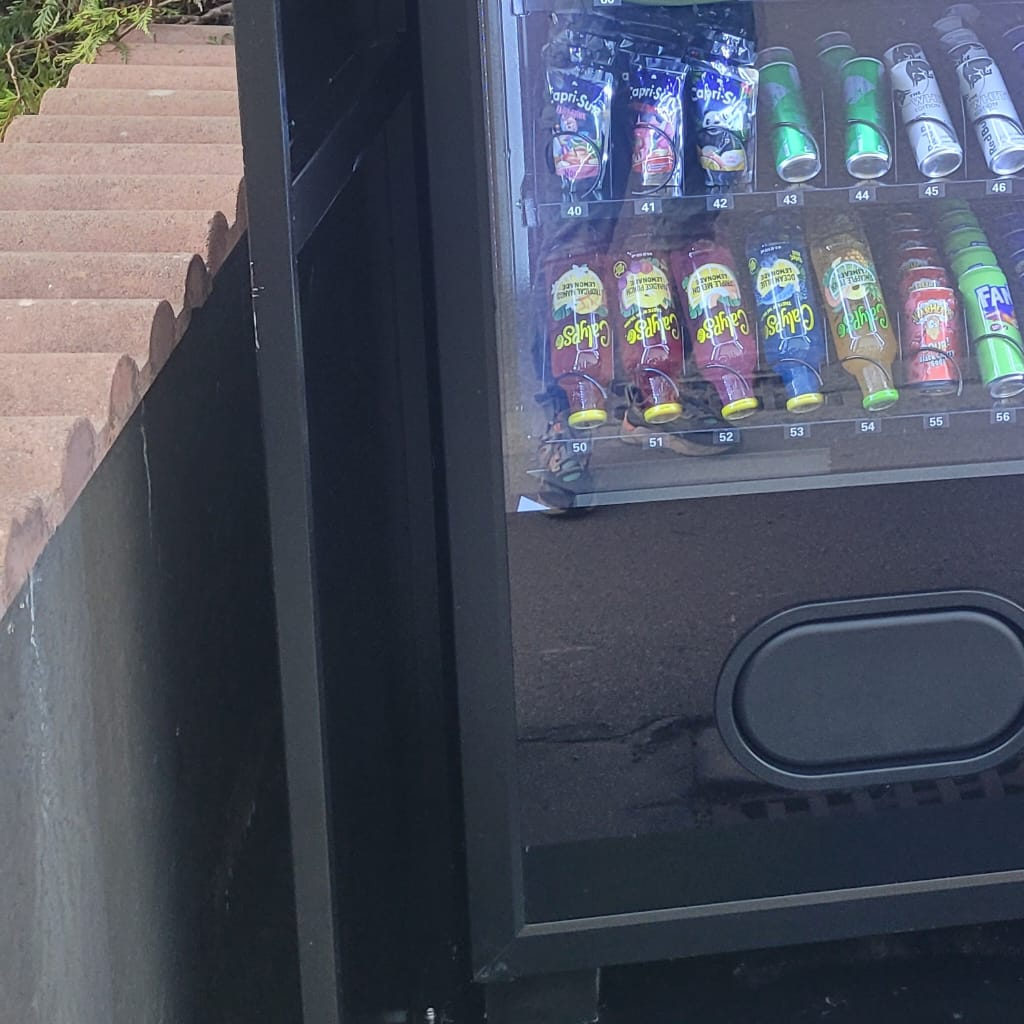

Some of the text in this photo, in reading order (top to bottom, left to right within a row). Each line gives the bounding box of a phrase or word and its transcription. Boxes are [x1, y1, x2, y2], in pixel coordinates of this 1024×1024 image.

[924, 186, 939, 196] 45
[992, 182, 1006, 193] 46
[782, 194, 798, 206] 43
[855, 190, 870, 200] 44
[641, 202, 656, 212] 41
[712, 198, 728, 208] 42
[567, 206, 582, 216] 40
[976, 285, 1014, 310] FAN
[837, 304, 889, 338] Calypso
[626, 313, 680, 345] Calypso
[697, 309, 750, 344] Calypso
[555, 319, 610, 351] Calypso
[929, 417, 944, 427] 55
[996, 412, 1010, 422] 56
[860, 422, 876, 432] 54
[718, 432, 734, 442] 52
[790, 428, 804, 438] 53
[572, 442, 587, 453] 50
[649, 438, 663, 448] 51
